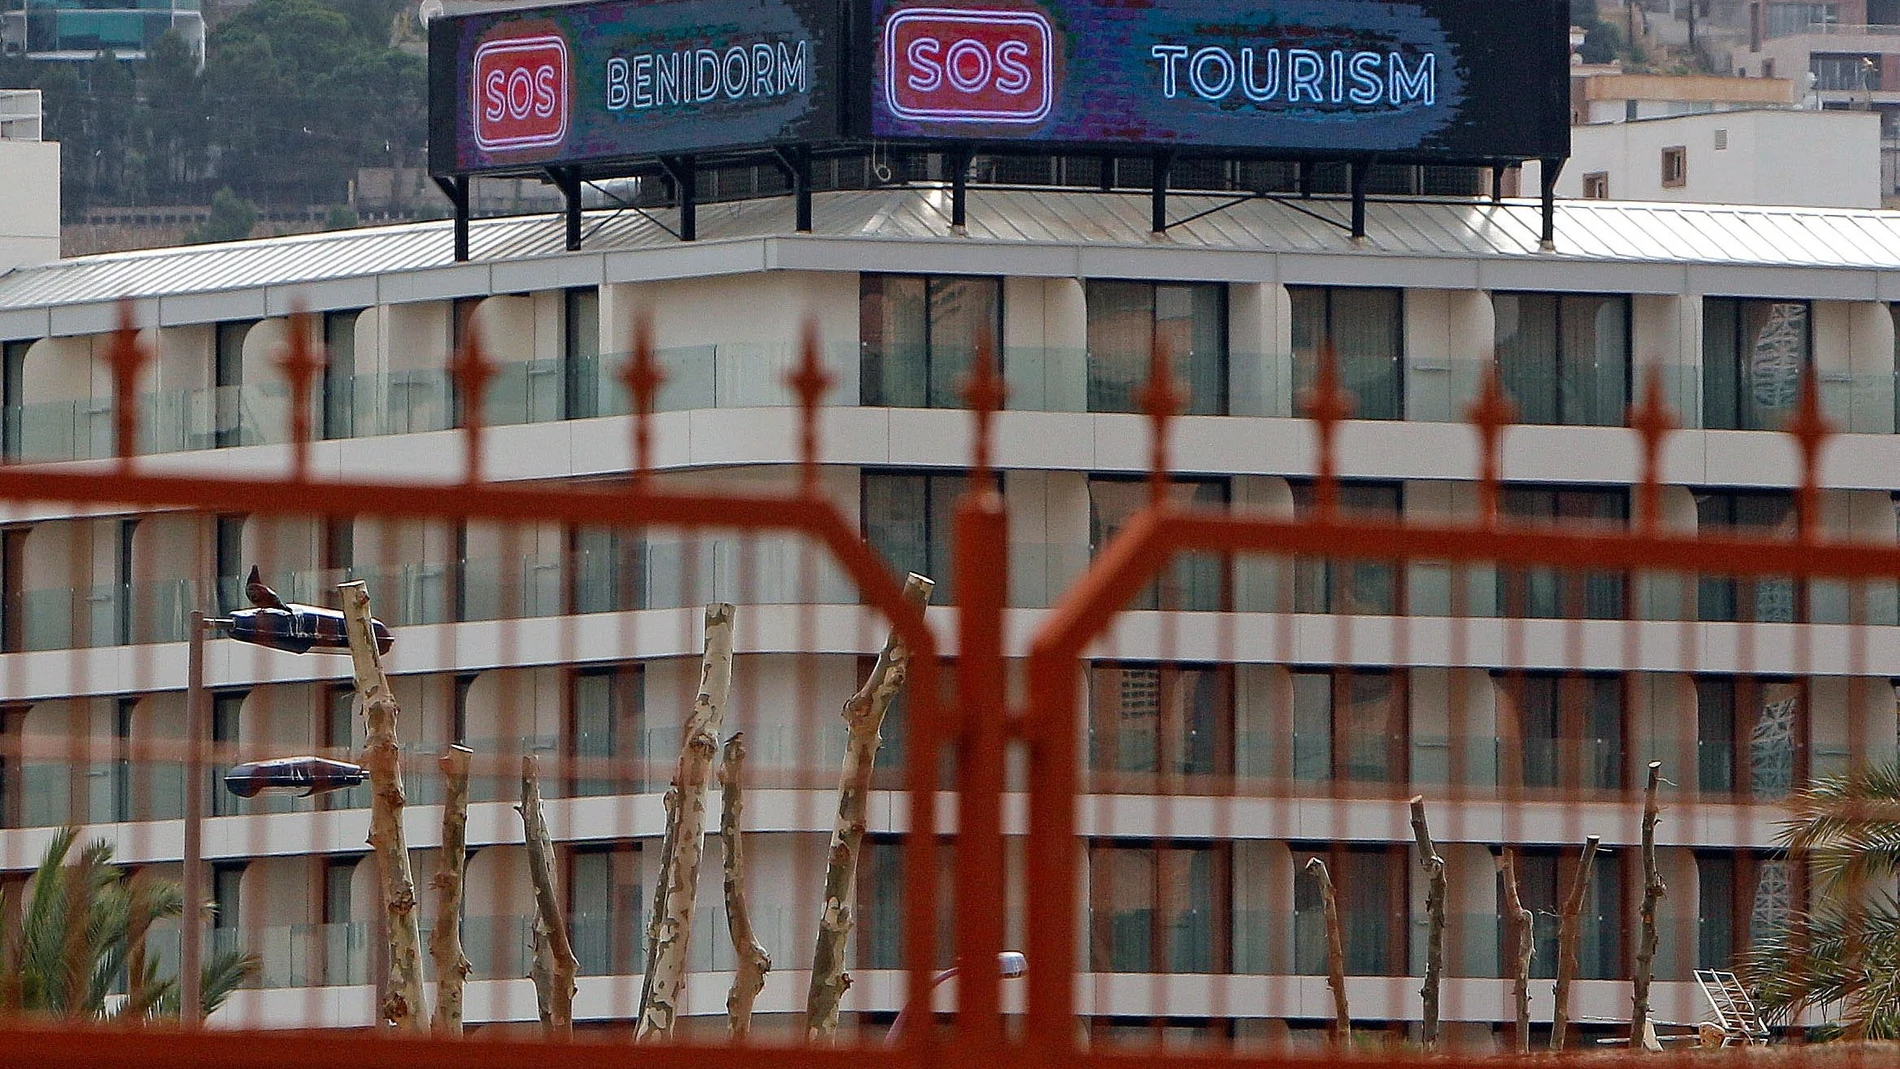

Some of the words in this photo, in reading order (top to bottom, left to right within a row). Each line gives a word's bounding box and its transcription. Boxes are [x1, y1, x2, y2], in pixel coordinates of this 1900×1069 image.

[485, 64, 555, 123] SOS
[606, 39, 807, 111] BENIDORM
[907, 37, 1032, 96] SOS
[1152, 44, 1436, 106] TOURISM
